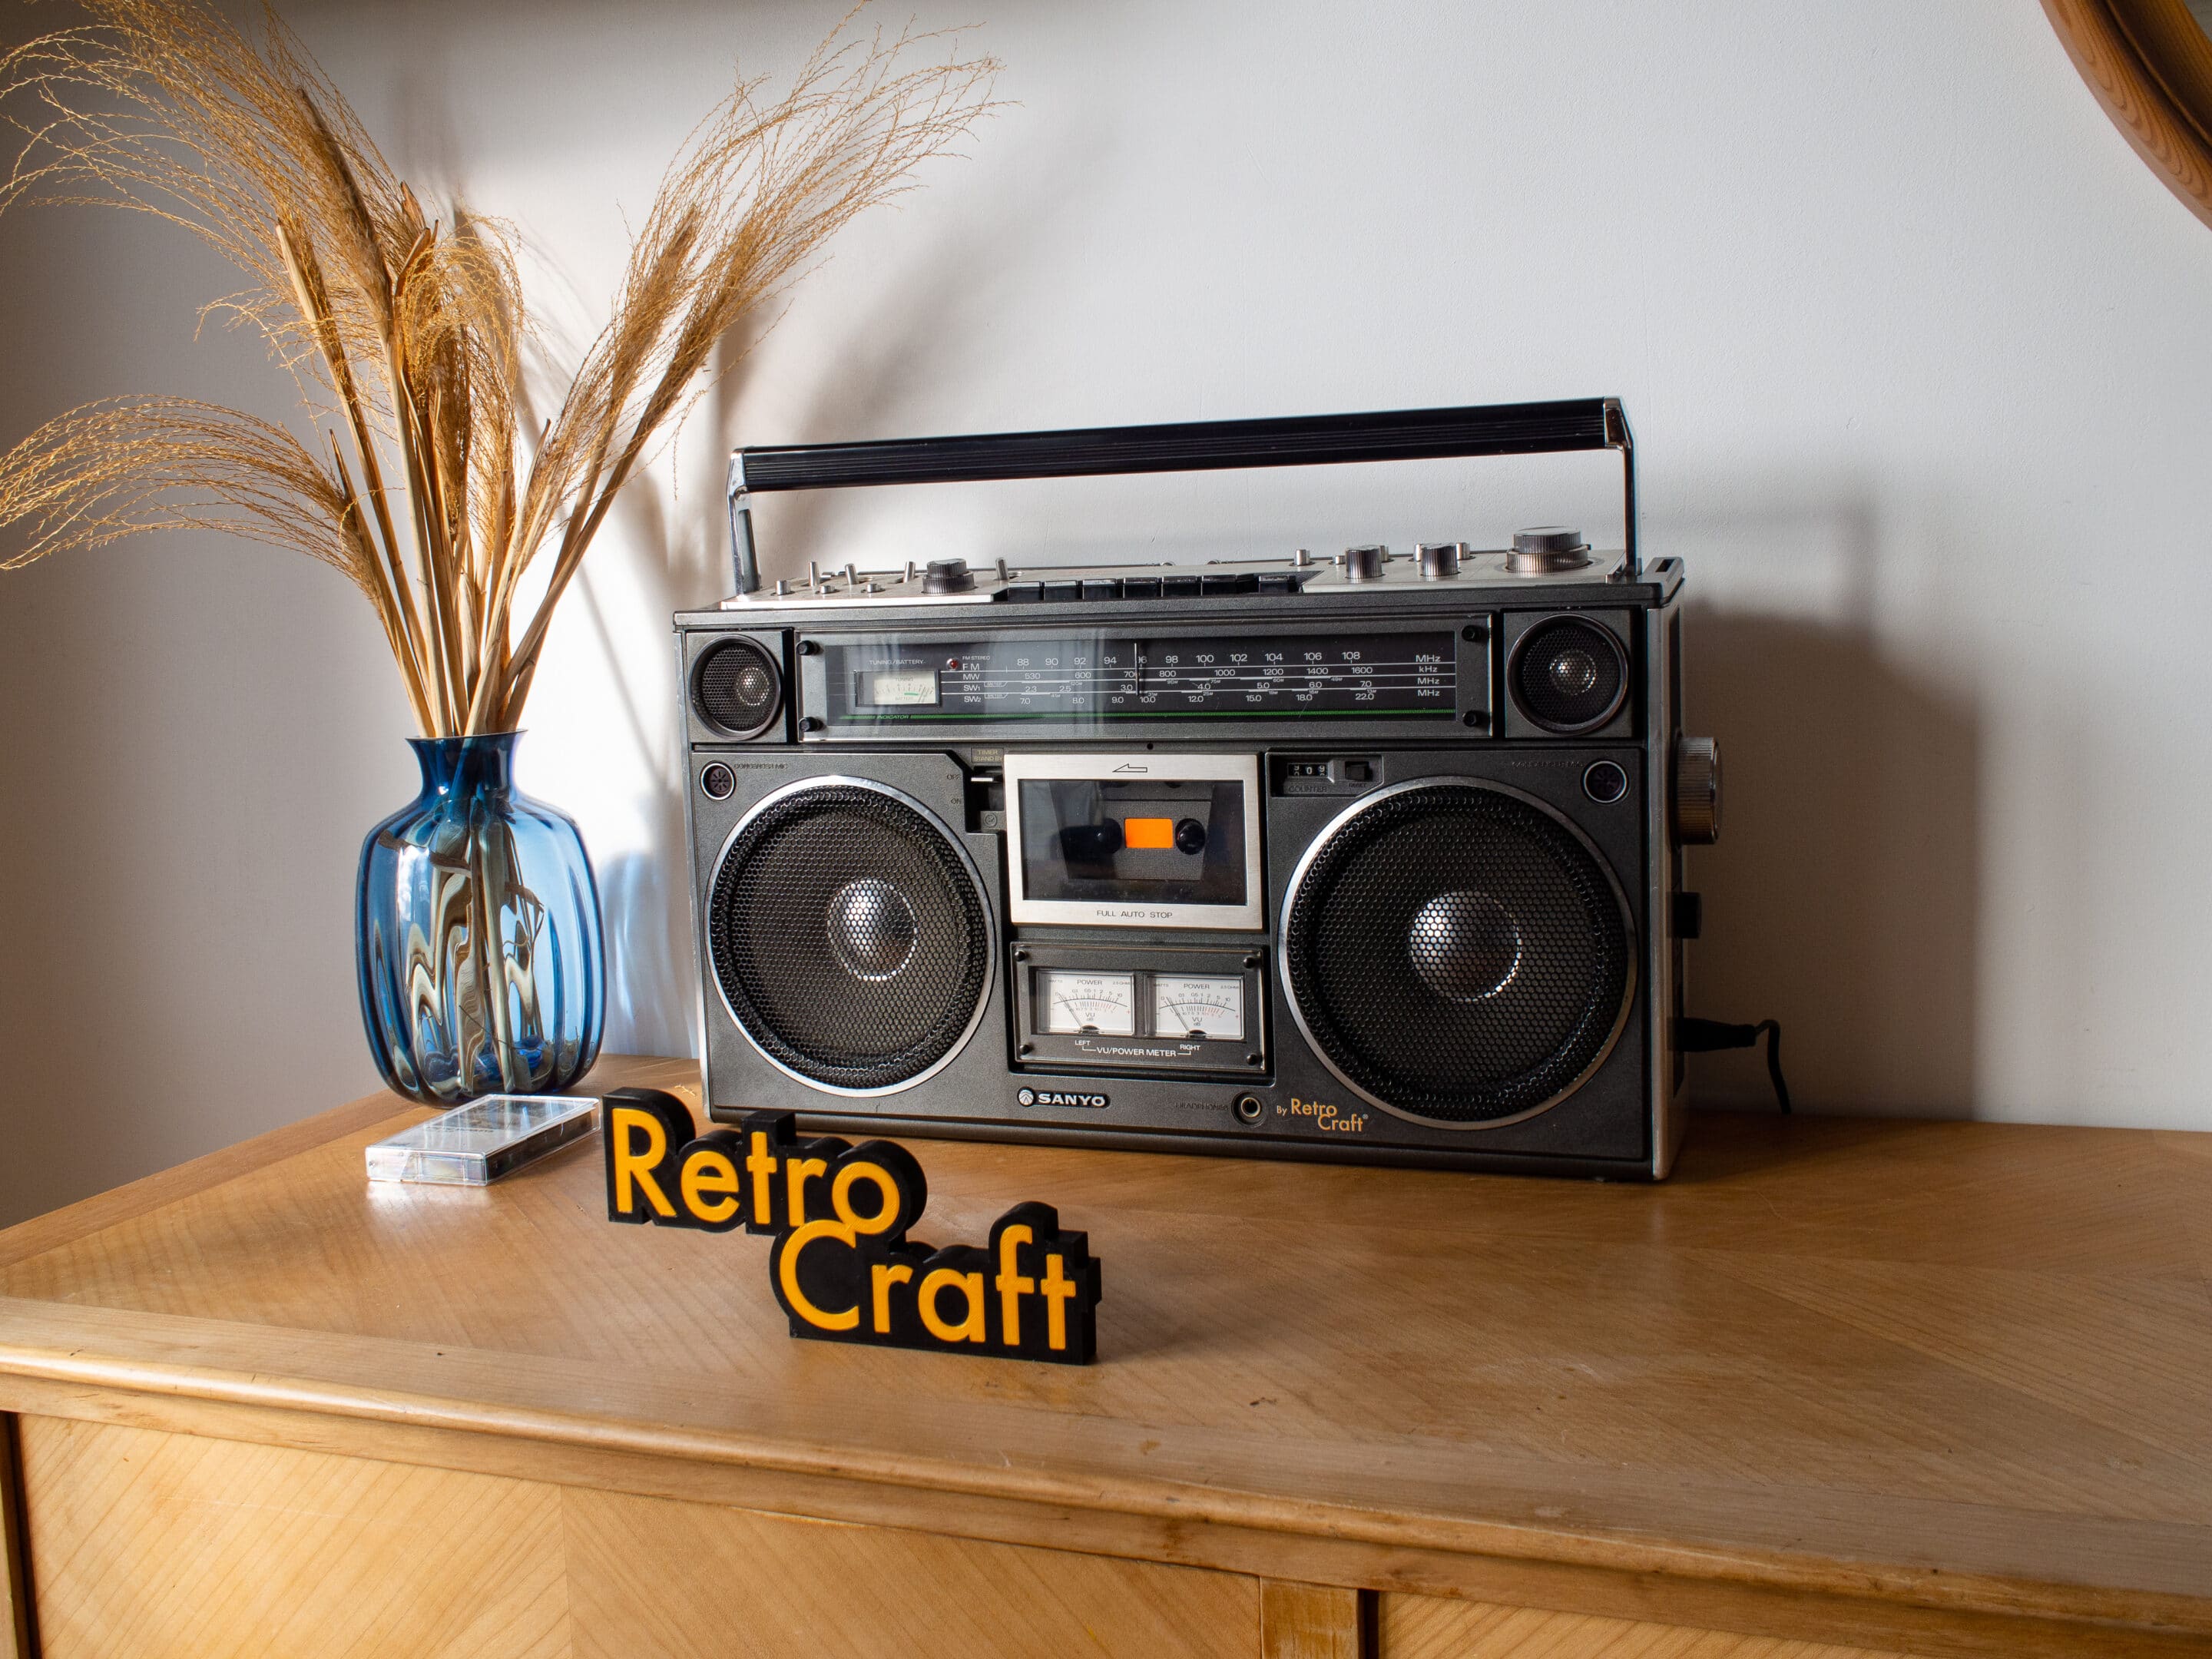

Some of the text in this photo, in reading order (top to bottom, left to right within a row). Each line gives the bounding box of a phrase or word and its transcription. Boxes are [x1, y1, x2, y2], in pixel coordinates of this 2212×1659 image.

[1165, 655, 1178, 664] 98
[1196, 654, 1214, 663] 100
[1230, 654, 1248, 662] 102
[1265, 653, 1283, 661] 104
[1096, 1046, 1144, 1055] VU/POWER
[1038, 1093, 1105, 1106] SANYO
[1277, 1098, 1338, 1117] By Retro
[612, 1108, 900, 1235] Retro
[780, 1219, 1076, 1350] Craft
